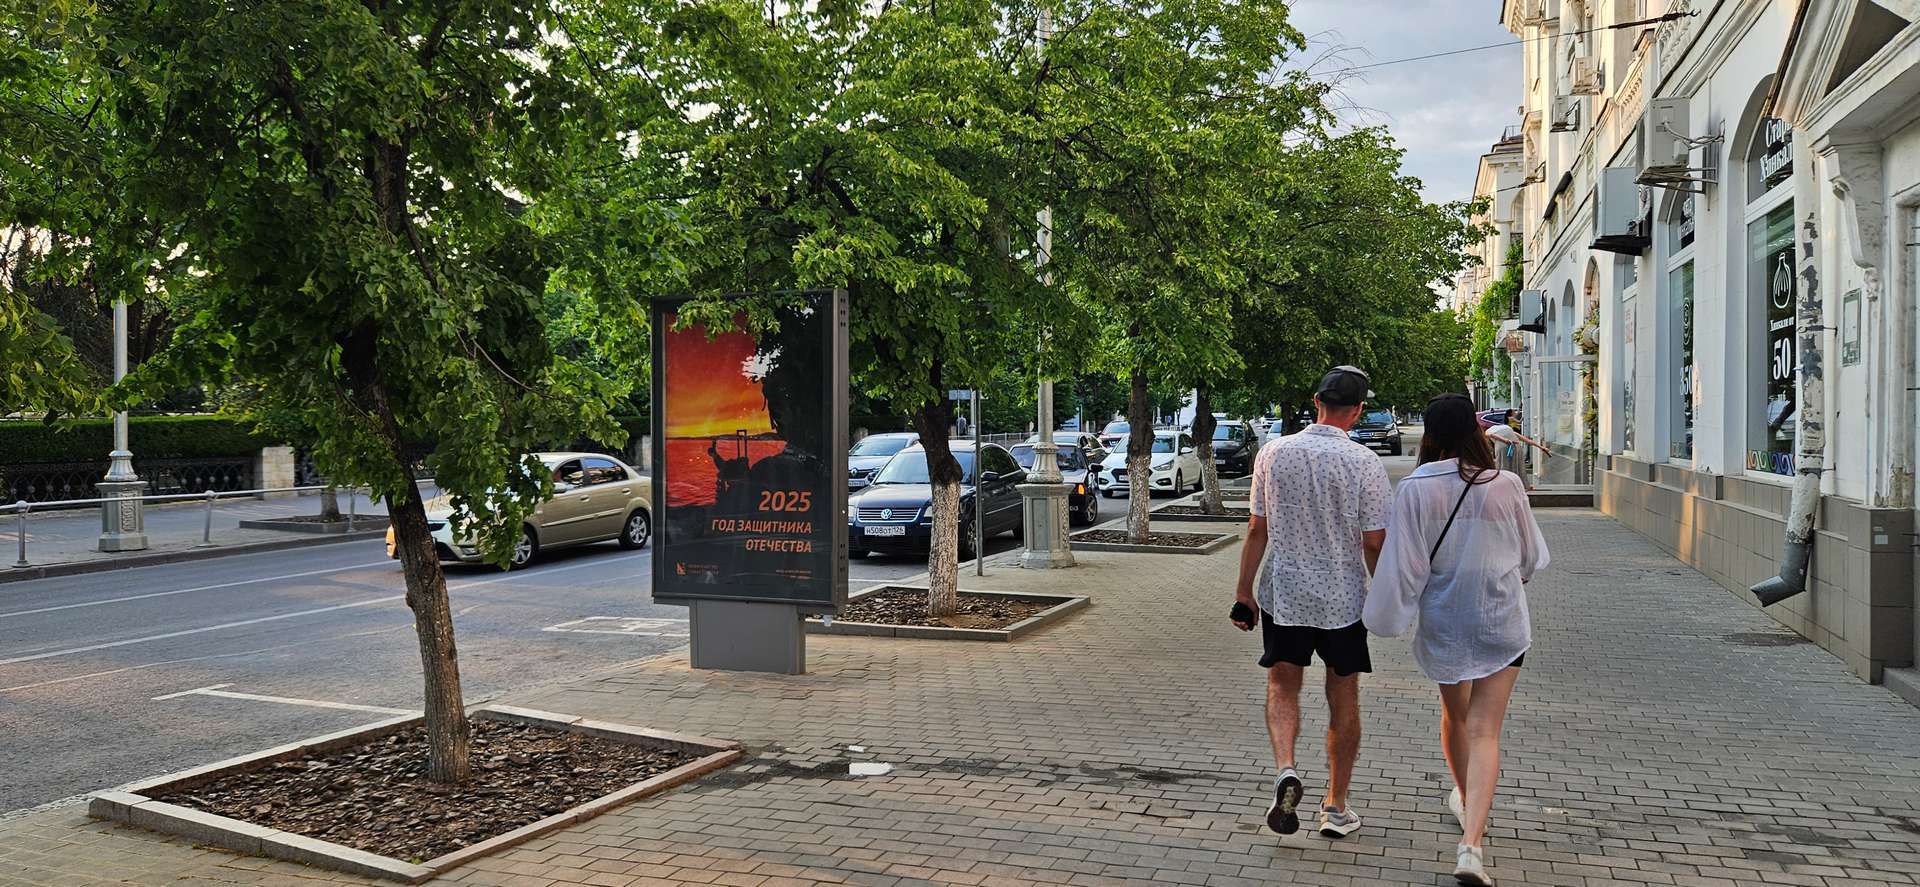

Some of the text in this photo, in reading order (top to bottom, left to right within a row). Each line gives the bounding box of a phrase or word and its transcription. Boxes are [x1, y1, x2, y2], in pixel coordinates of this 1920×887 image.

[1773, 337, 1791, 380] 50
[758, 490, 812, 512] 2025
[712, 519, 812, 534] ГОД ЗАЩИТНИКА
[745, 539, 812, 552] ОТЕЧЕСТВА
